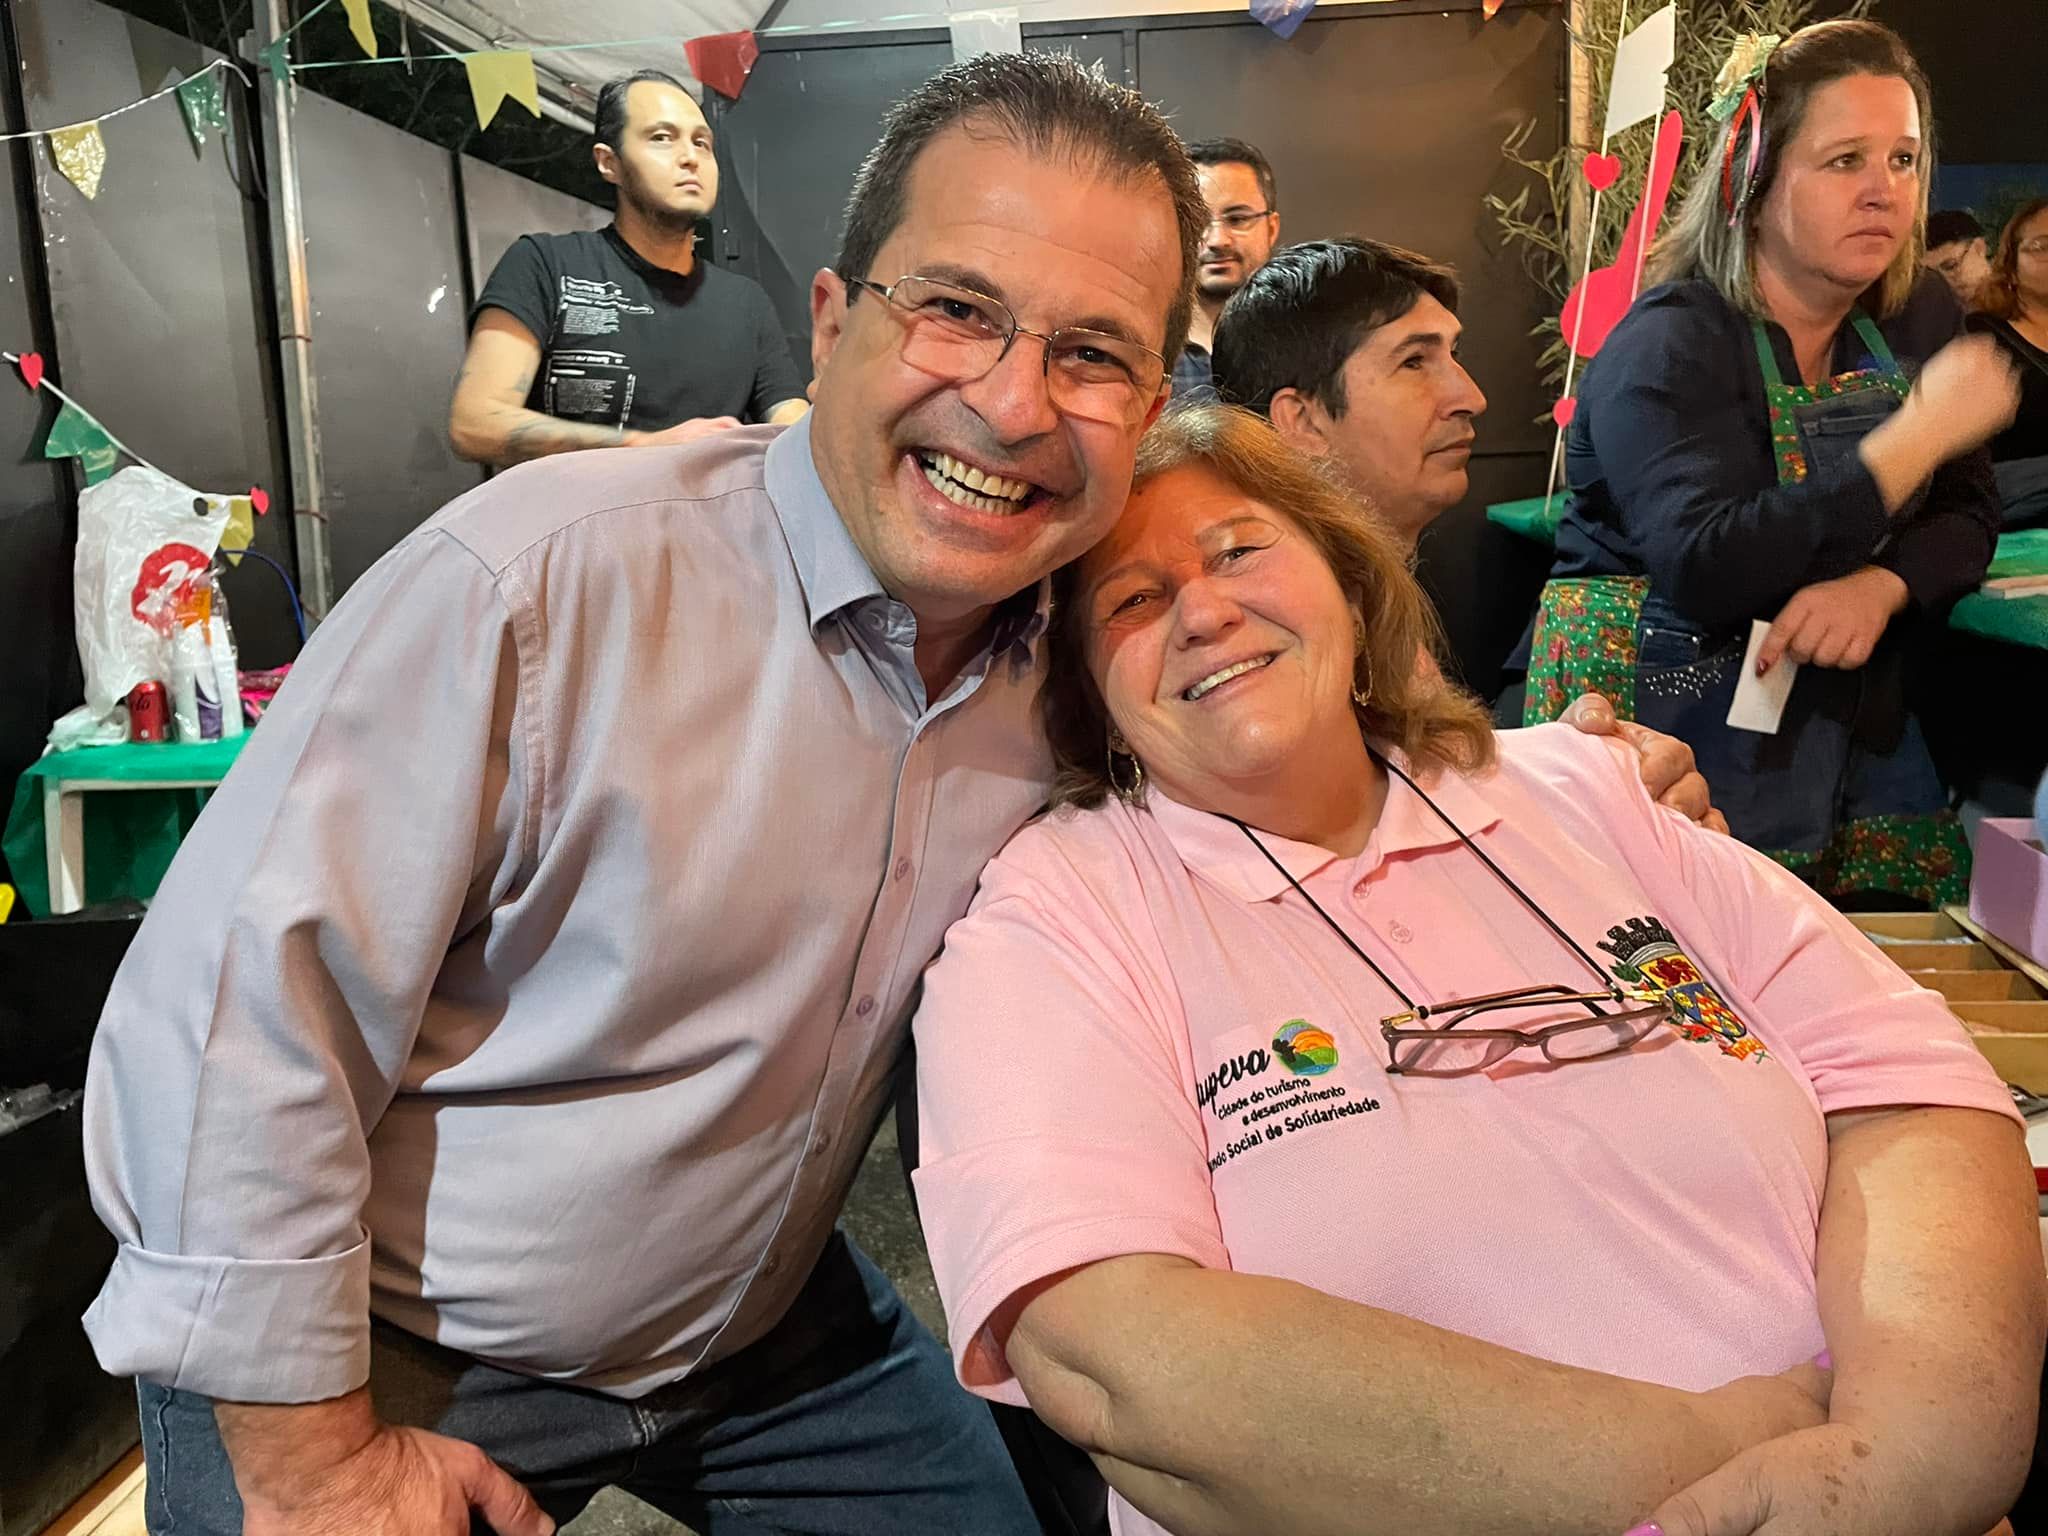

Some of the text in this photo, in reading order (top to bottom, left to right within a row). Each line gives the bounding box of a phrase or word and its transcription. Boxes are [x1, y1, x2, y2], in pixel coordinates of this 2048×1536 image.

[1196, 1048, 1270, 1115] upeva
[1242, 1085, 1346, 1126] e desenvolvimento
[1250, 1089, 1265, 1105] do
[1265, 1076, 1311, 1098] turismo
[1226, 1129, 1263, 1159] Social
[1265, 1123, 1283, 1141] de
[1284, 1096, 1380, 1133] Solidariedade
